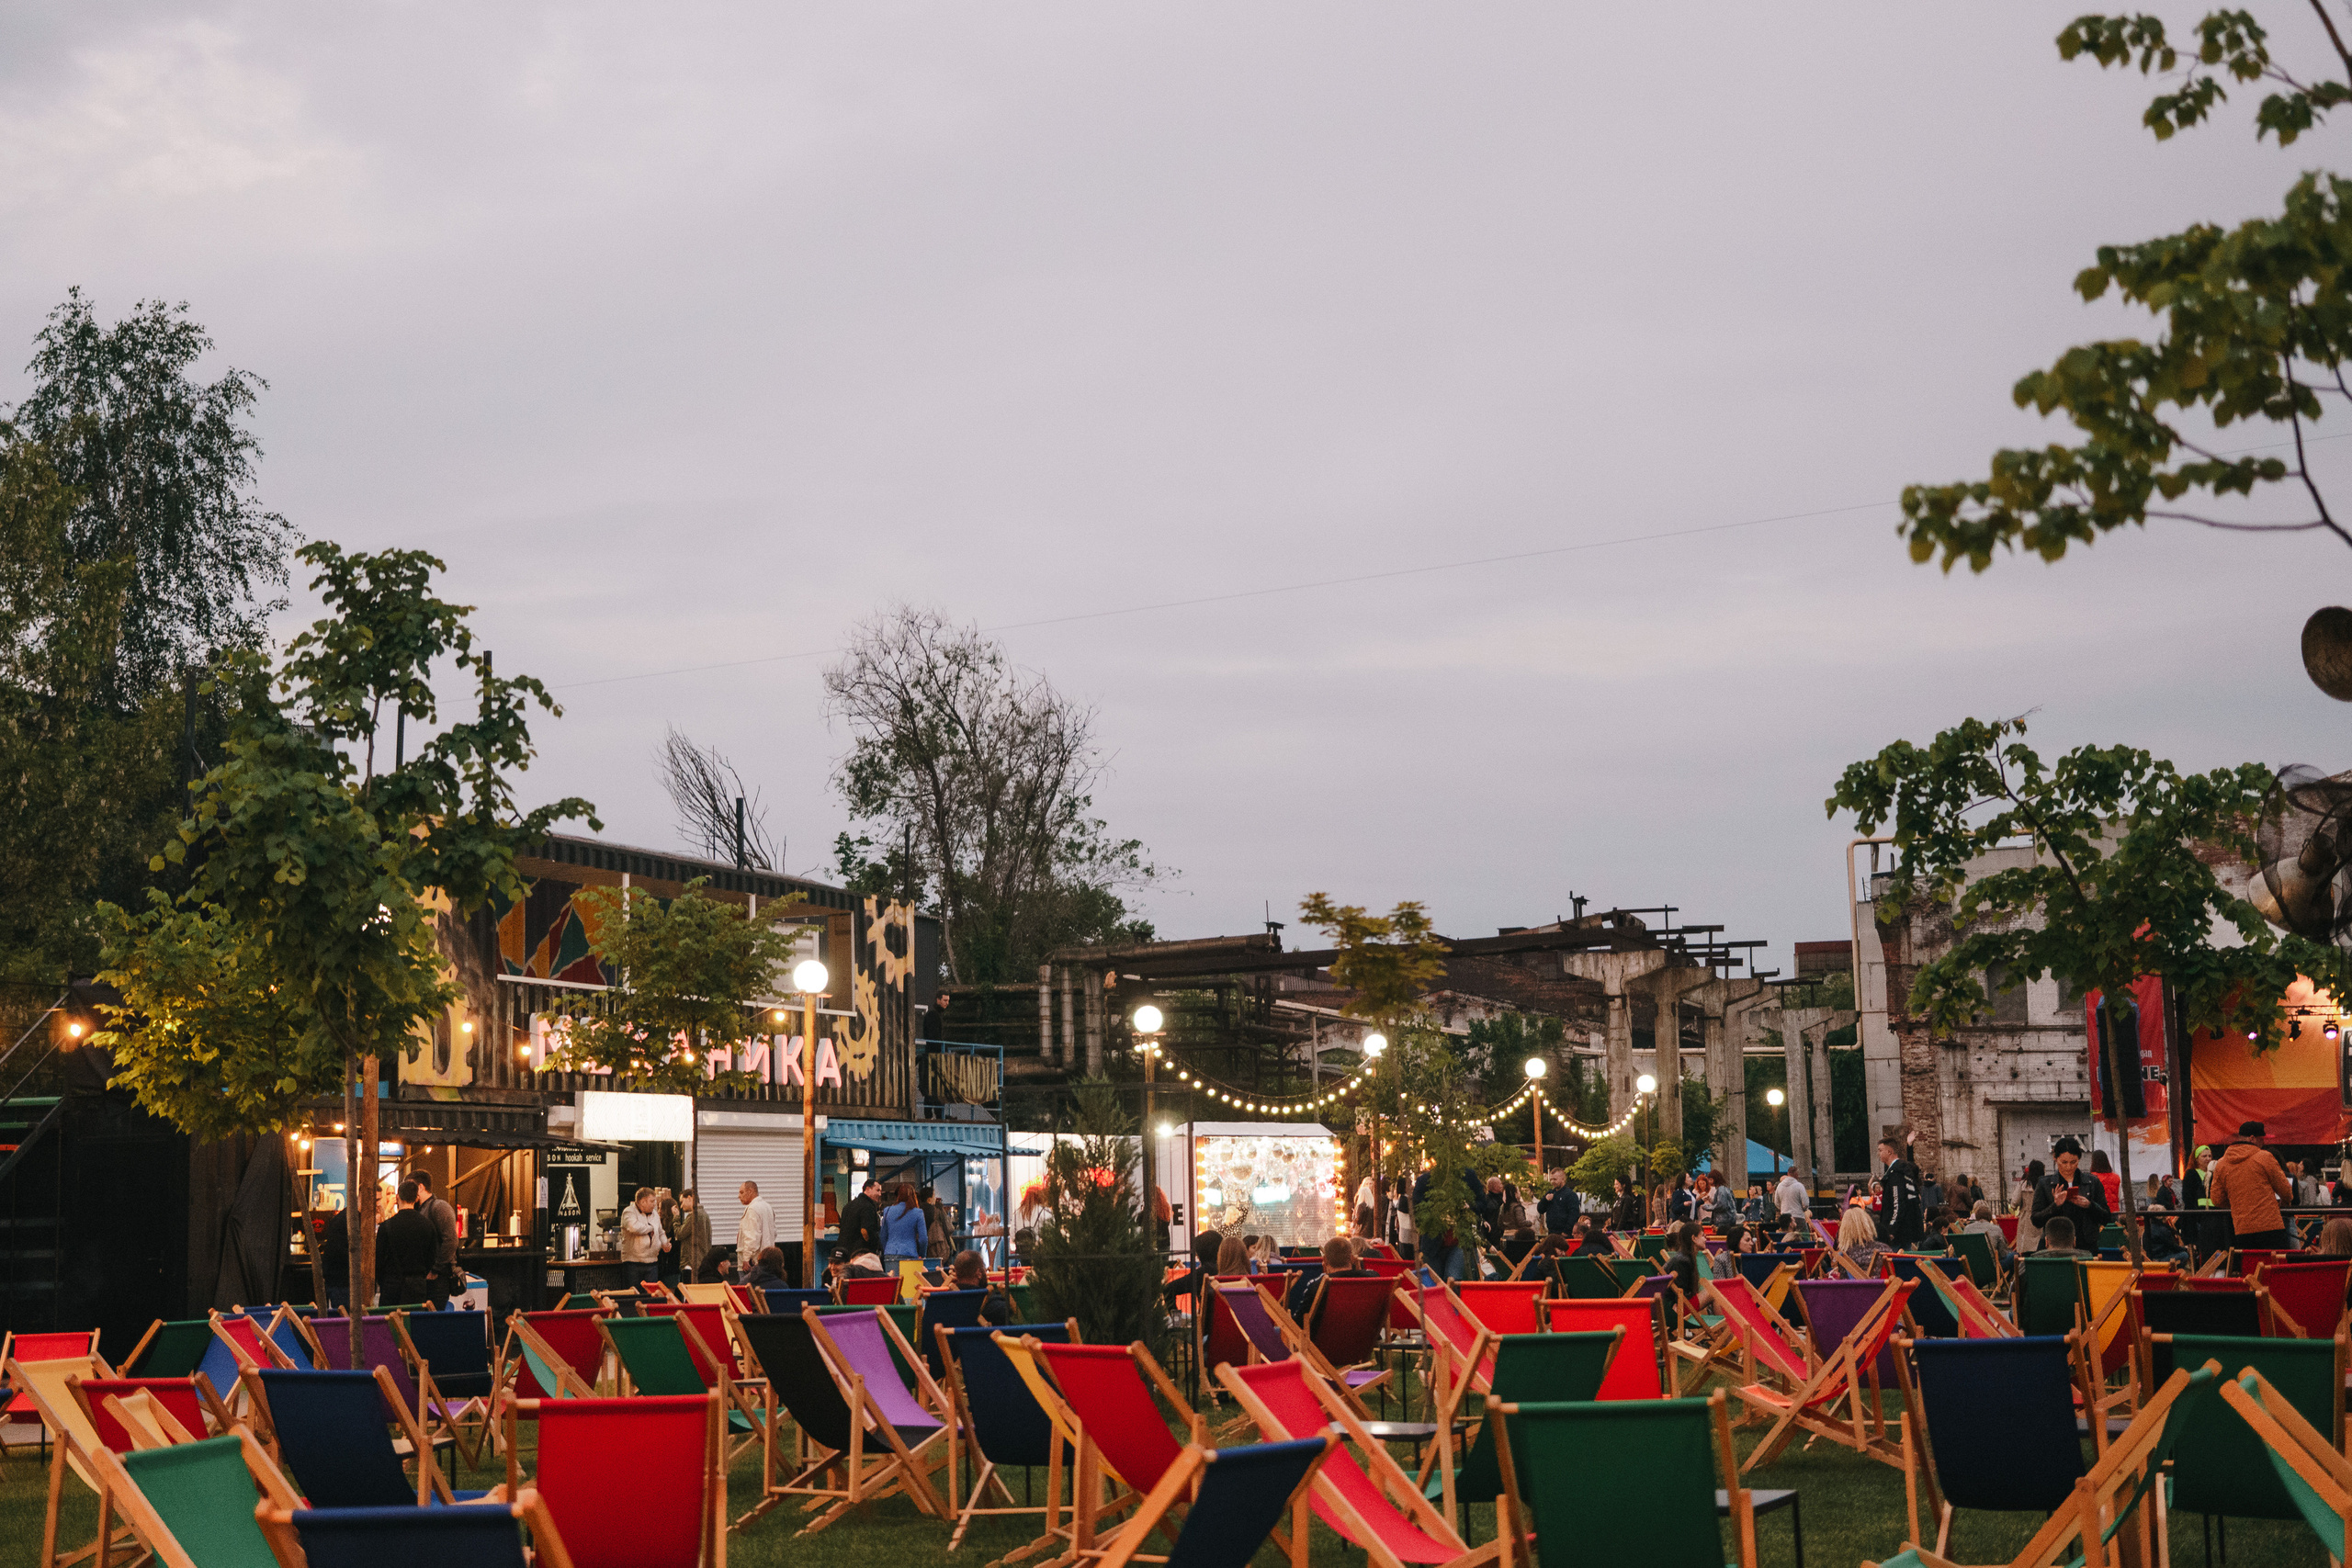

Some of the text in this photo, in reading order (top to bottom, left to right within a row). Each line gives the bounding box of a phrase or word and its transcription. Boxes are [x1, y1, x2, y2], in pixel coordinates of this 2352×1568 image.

[928, 1053, 1000, 1102] FINLANDIA
[565, 1153, 582, 1162] hookah
[585, 1153, 602, 1162] service
